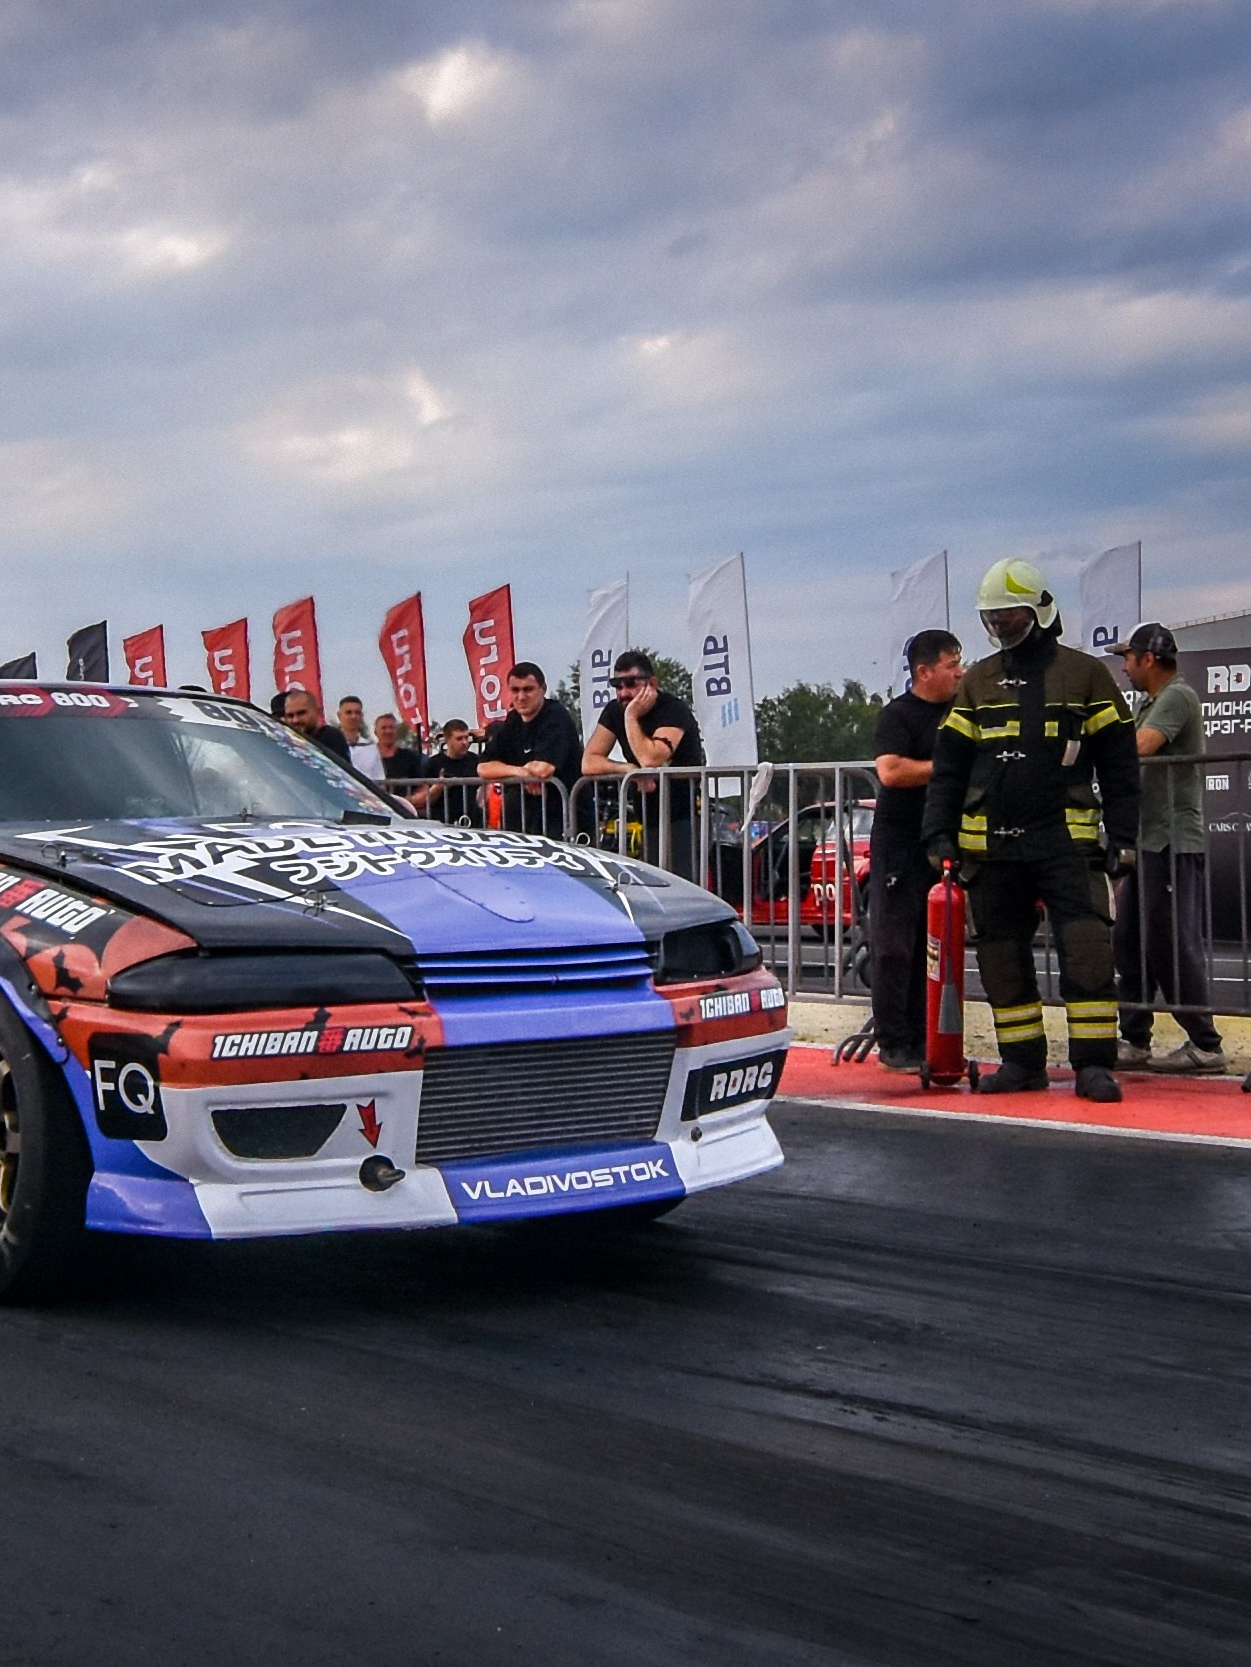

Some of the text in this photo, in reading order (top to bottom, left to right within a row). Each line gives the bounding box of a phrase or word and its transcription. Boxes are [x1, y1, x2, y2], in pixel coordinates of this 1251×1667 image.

[1207, 664, 1251, 693] RD
[51, 692, 110, 707] 800
[1202, 700, 1251, 718] ПИОНА
[15, 888, 108, 934] AUTO
[343, 1026, 412, 1051] AUTO
[94, 1059, 155, 1115] FQ
[710, 1061, 773, 1101] RDRC
[461, 1159, 670, 1200] VLADIVOSTOK
